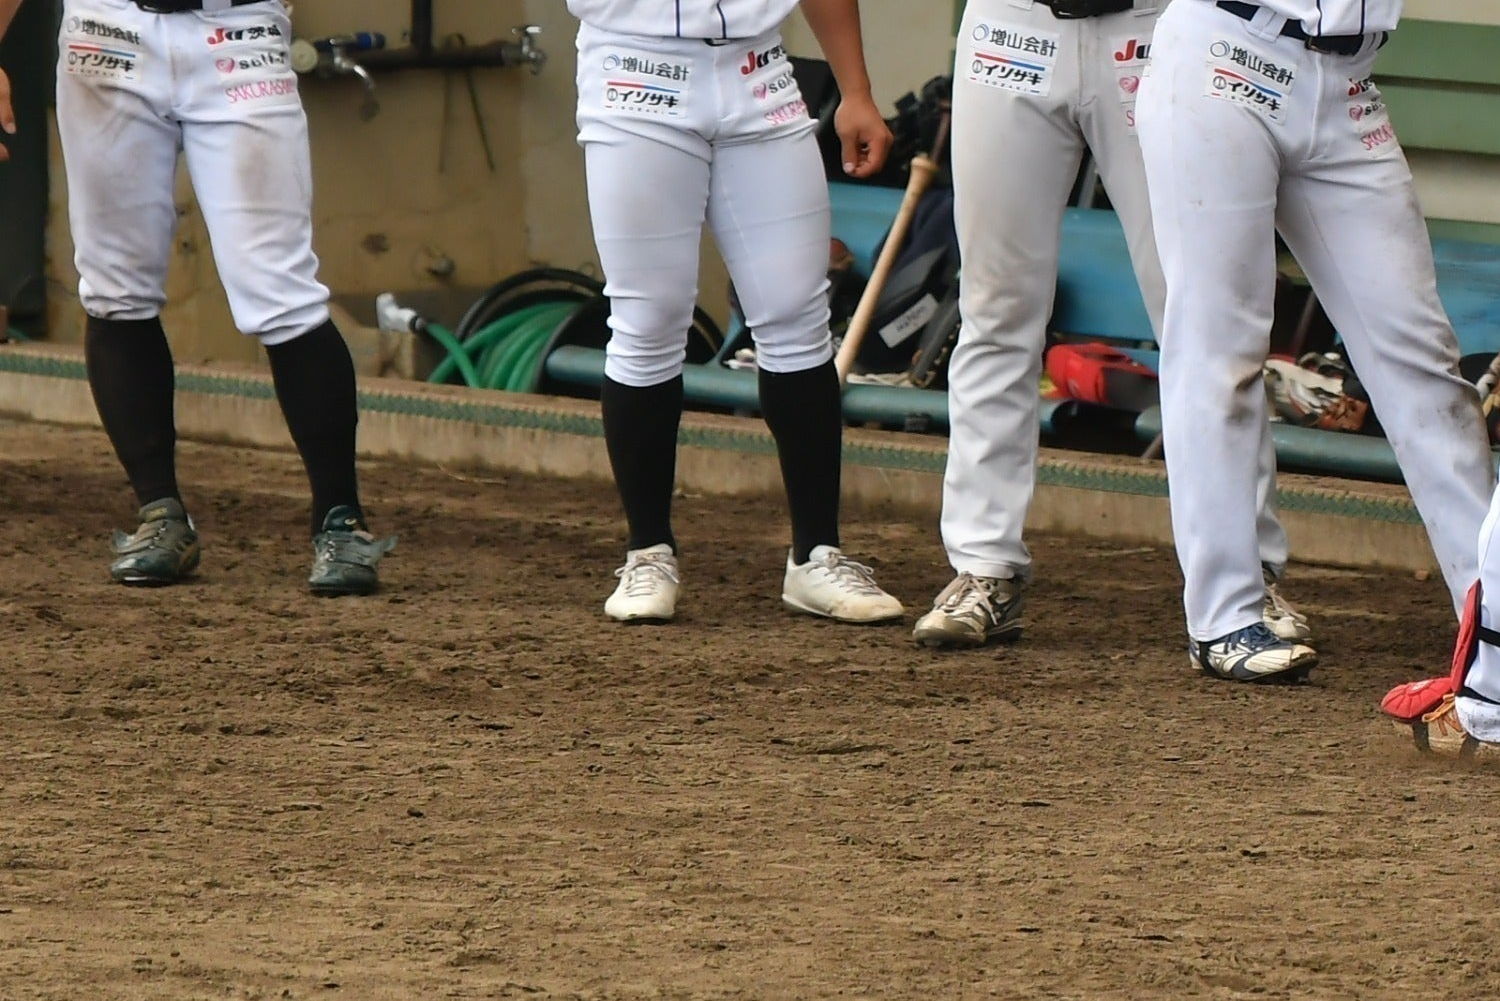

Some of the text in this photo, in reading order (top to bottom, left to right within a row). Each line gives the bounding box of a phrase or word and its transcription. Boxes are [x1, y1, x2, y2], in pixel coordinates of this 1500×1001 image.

[991, 27, 1058, 58] 増山会計
[621, 56, 690, 82] 増山会計
[985, 64, 1043, 86] イソザキ
[1229, 45, 1295, 88] 増山会計
[619, 90, 680, 109] イソザキ
[1226, 81, 1282, 112] イソザキ
